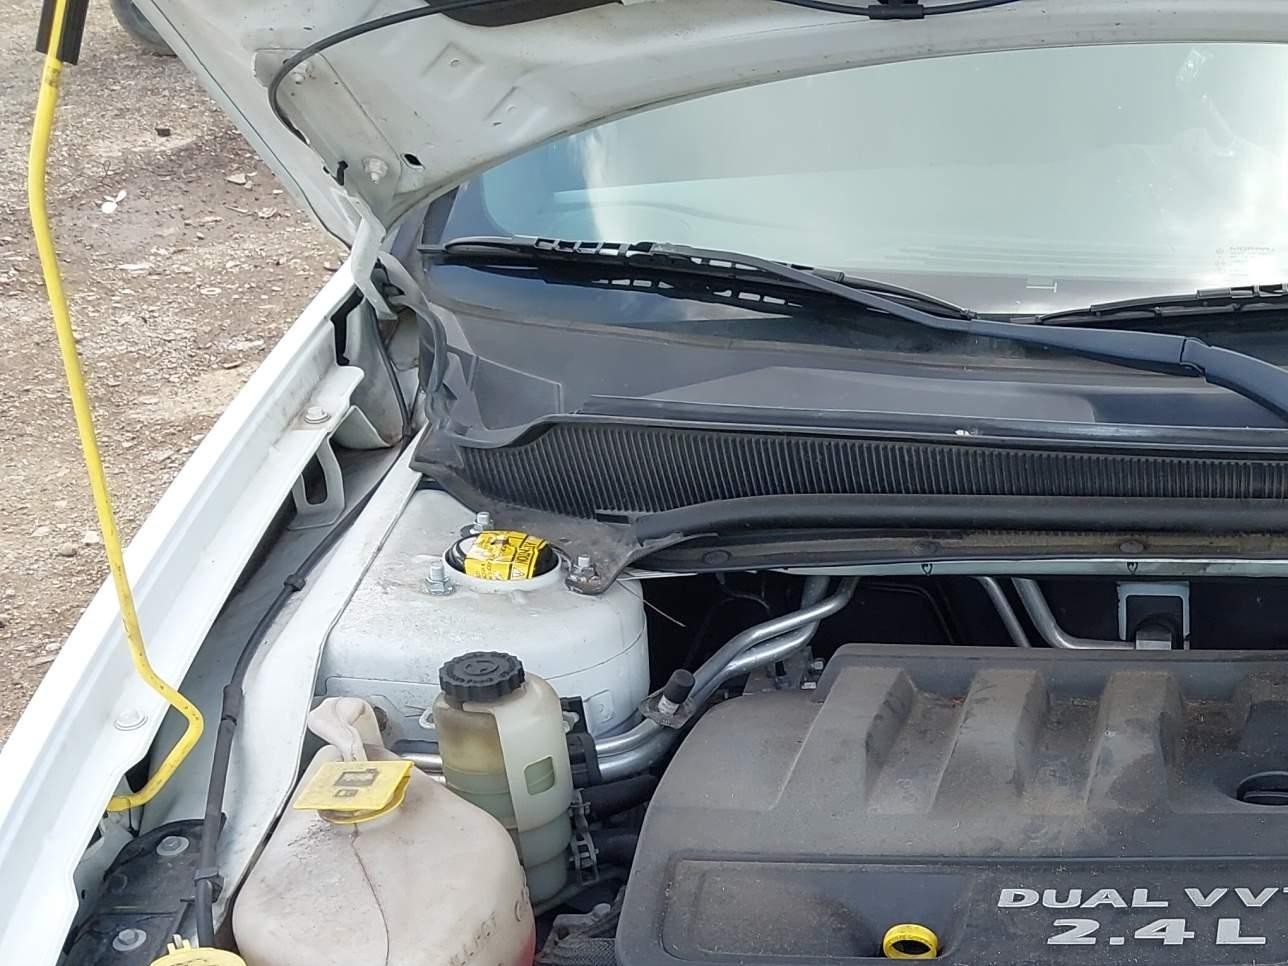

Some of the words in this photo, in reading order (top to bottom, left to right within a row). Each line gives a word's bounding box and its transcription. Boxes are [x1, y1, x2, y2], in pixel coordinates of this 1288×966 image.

[997, 888, 1169, 909] DUAL
[1047, 918, 1196, 946] 2.4
[1215, 918, 1266, 946] L
